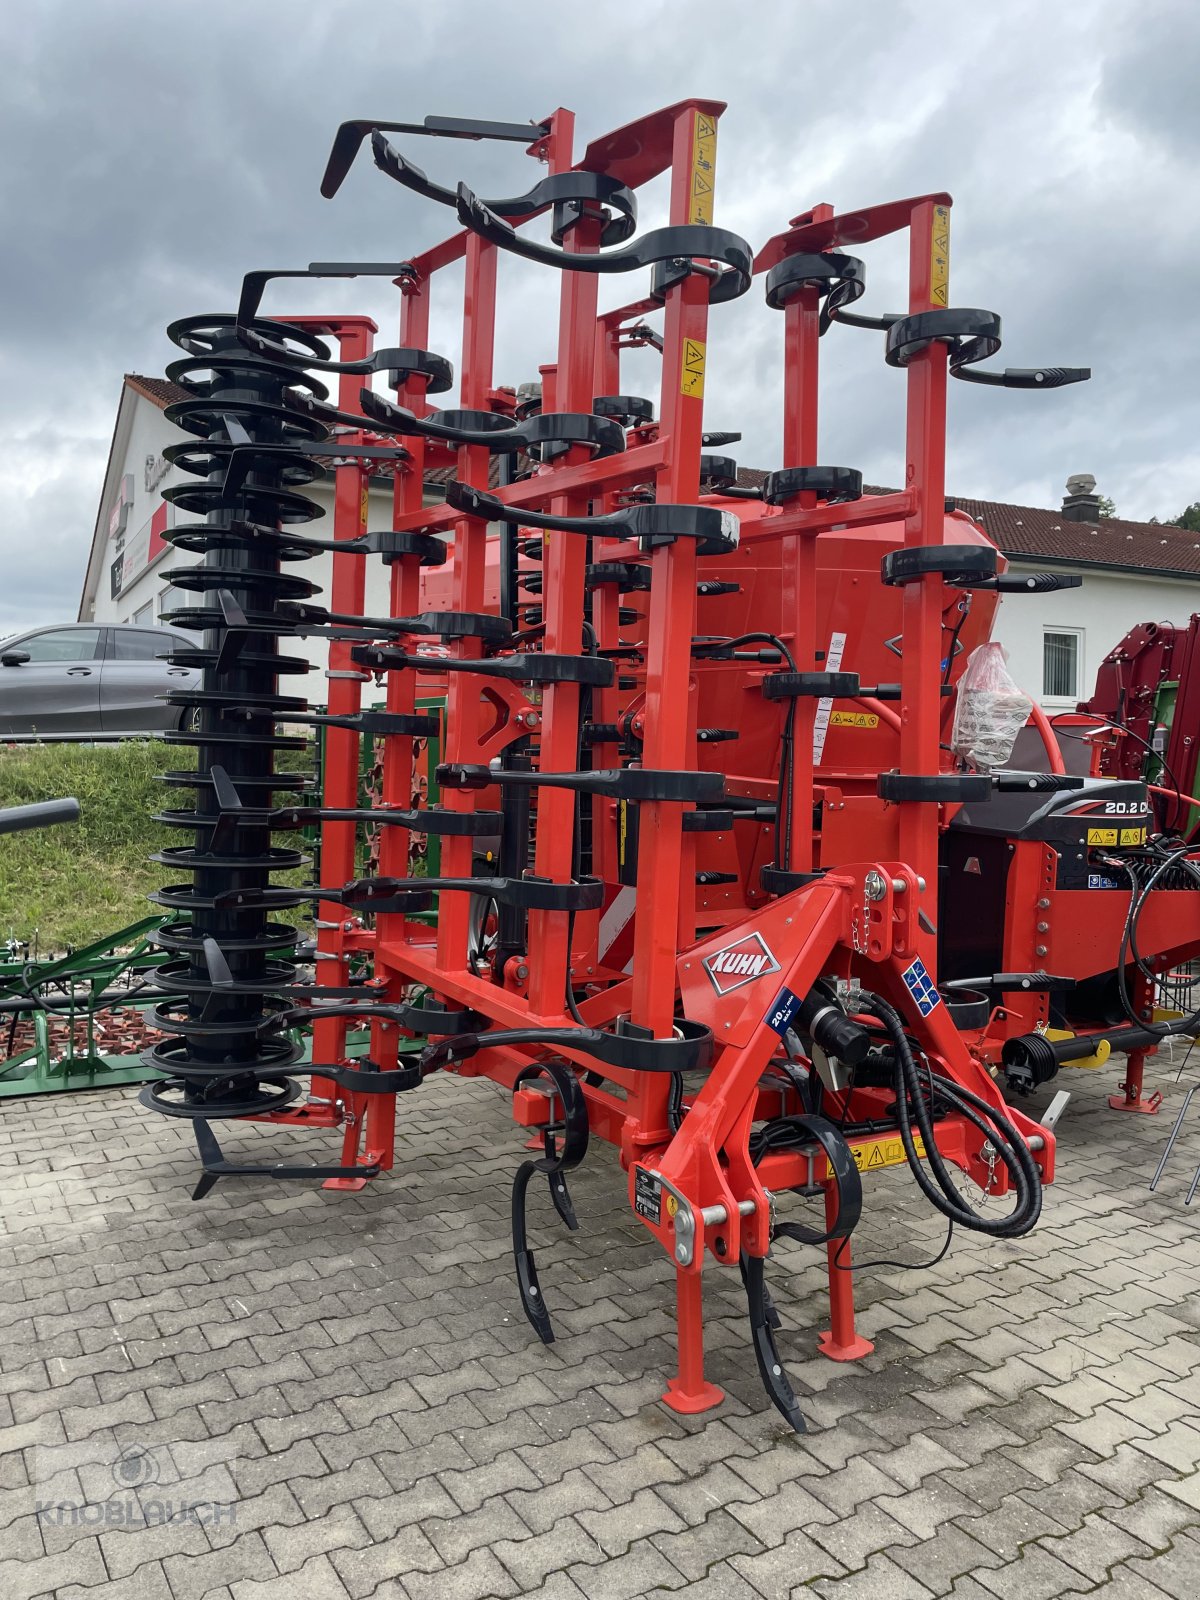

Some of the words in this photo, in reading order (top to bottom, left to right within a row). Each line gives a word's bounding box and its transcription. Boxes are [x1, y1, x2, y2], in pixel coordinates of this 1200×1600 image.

[1105, 802, 1138, 814] 20.2
[711, 952, 769, 976] KUHN
[772, 1011, 782, 1027] 20
[783, 1009, 792, 1022] MAX
